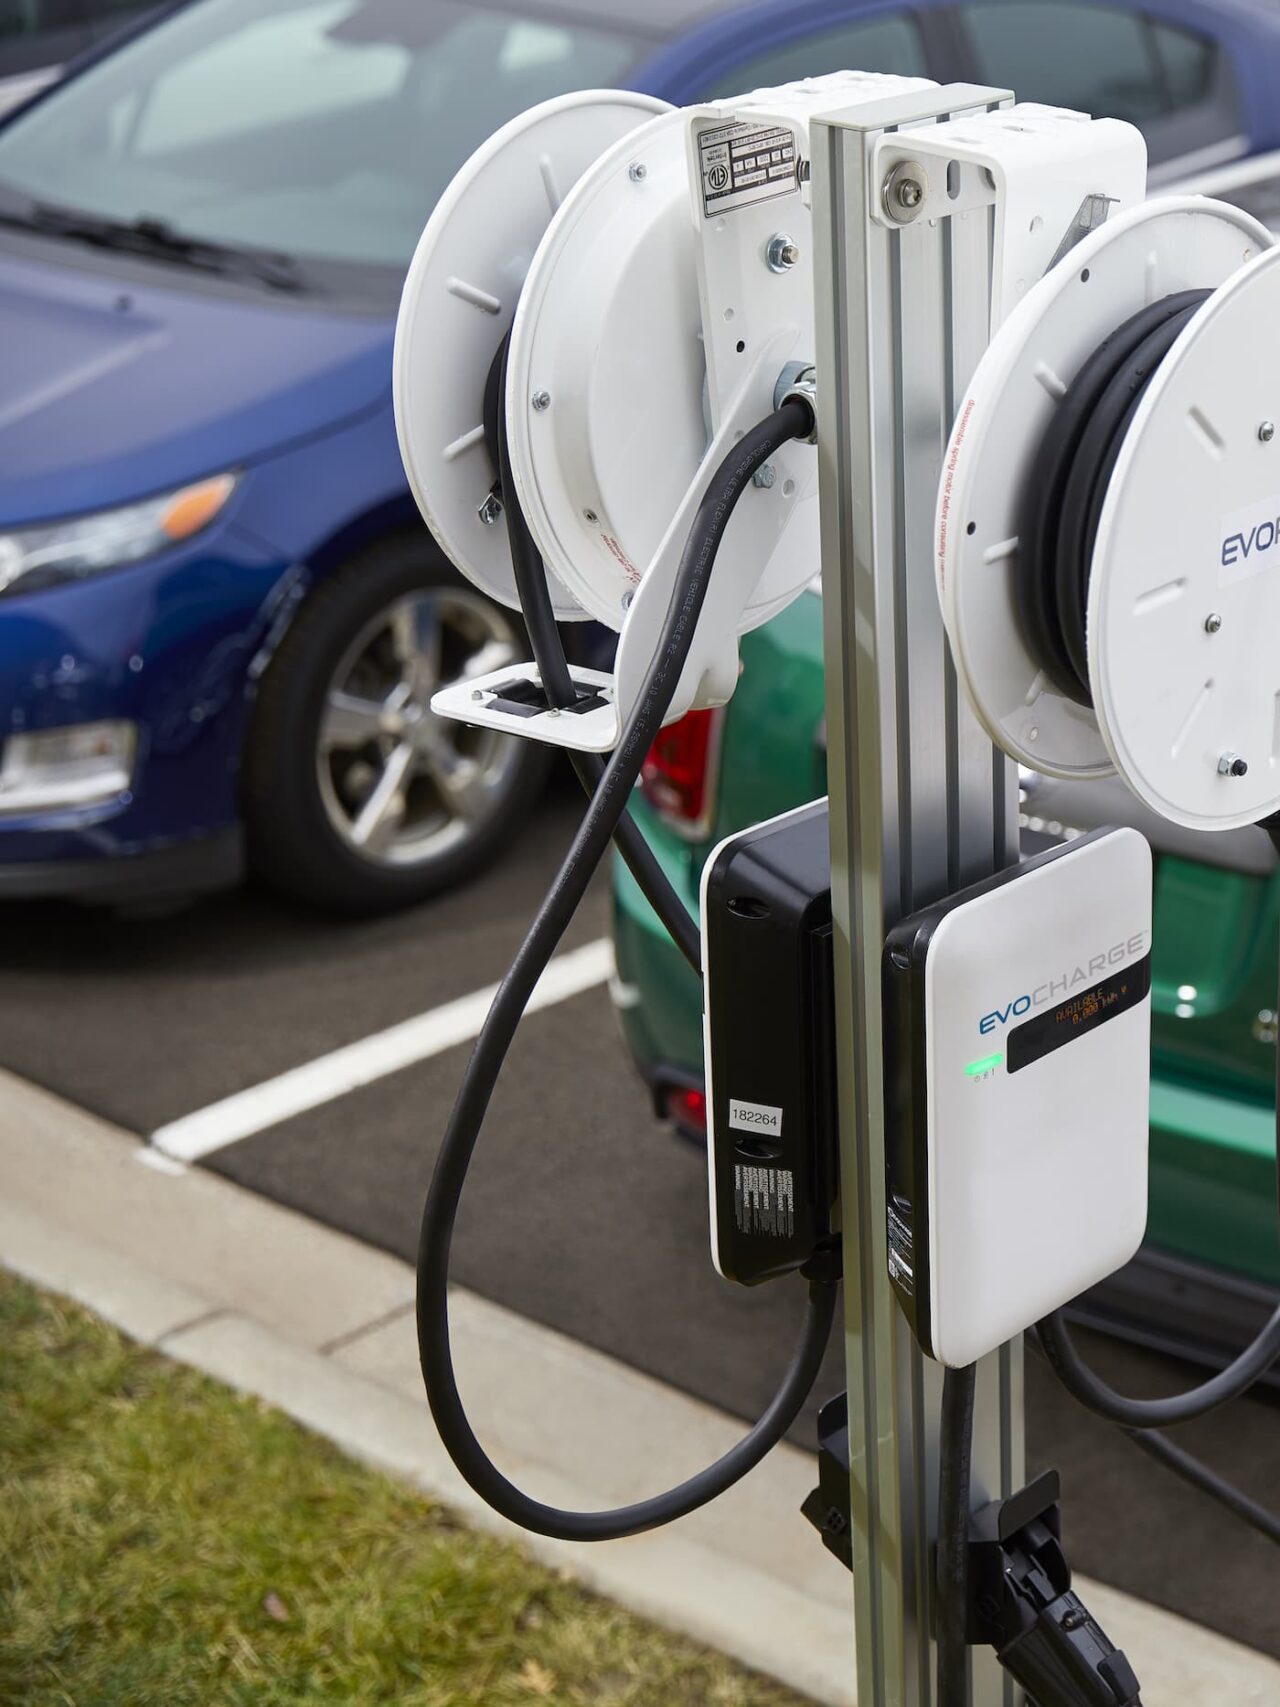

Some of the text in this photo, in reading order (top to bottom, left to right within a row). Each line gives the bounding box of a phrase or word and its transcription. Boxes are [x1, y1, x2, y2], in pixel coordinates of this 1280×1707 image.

[693, 535, 714, 576] ELECTRIC
[681, 577, 701, 612] VEHICLE
[671, 614, 688, 640] CABLE
[979, 932, 1144, 1035] EVOCHARGE
[733, 1108, 777, 1127] 182264
